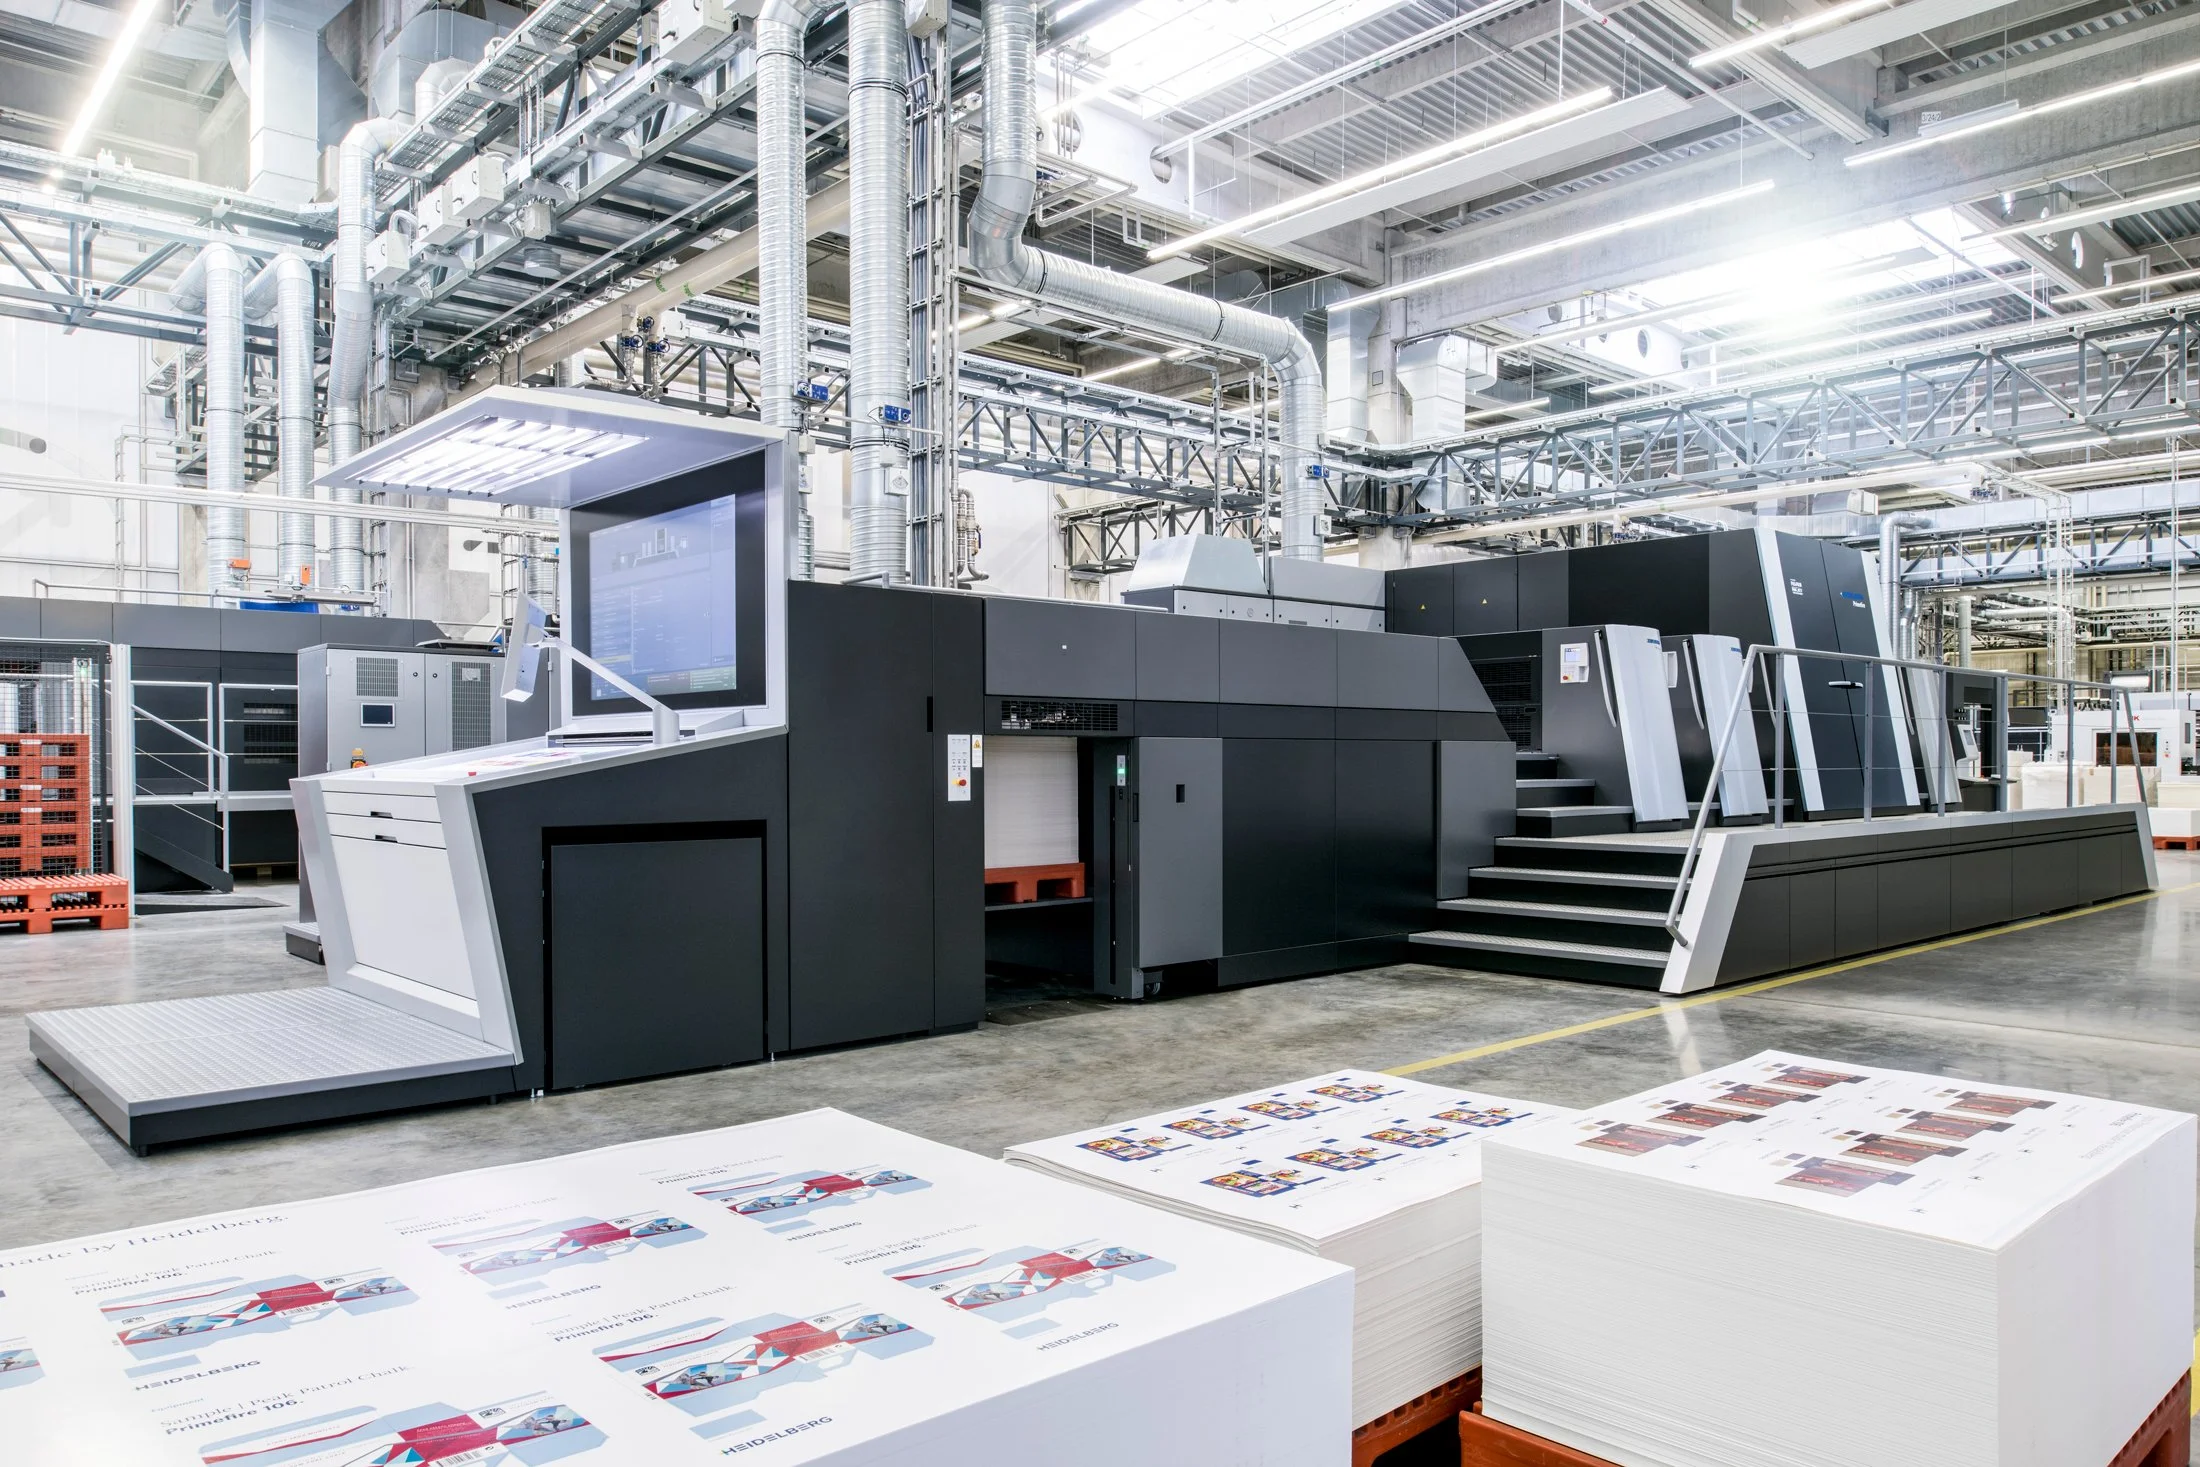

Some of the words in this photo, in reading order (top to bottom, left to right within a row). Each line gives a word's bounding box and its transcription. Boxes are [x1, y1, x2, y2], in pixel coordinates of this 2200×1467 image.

[81, 1244, 116, 1255] by
[127, 1215, 288, 1246] Heidelberg.
[785, 1221, 862, 1242] HEIDELBERG
[844, 1250, 899, 1265] Primefire
[75, 1278, 150, 1295] Primefire
[153, 1271, 188, 1281] 106.
[505, 1284, 602, 1310] HEIDELBERG
[545, 1320, 600, 1336] Sample
[611, 1309, 646, 1321] Peak
[648, 1296, 691, 1312] Patrol
[554, 1321, 625, 1343] Primefire
[626, 1313, 660, 1324] 106.
[1036, 1322, 1120, 1351] HEIDELBERG
[135, 1360, 261, 1391] HEIDELBERG
[160, 1407, 233, 1426] Sample
[250, 1392, 295, 1407] Peak
[298, 1377, 353, 1395] Patrol
[357, 1366, 416, 1380] Chalk.
[165, 1409, 258, 1436] Primefire
[260, 1399, 304, 1411] 106.
[721, 1416, 832, 1456] HEIDELBERG
